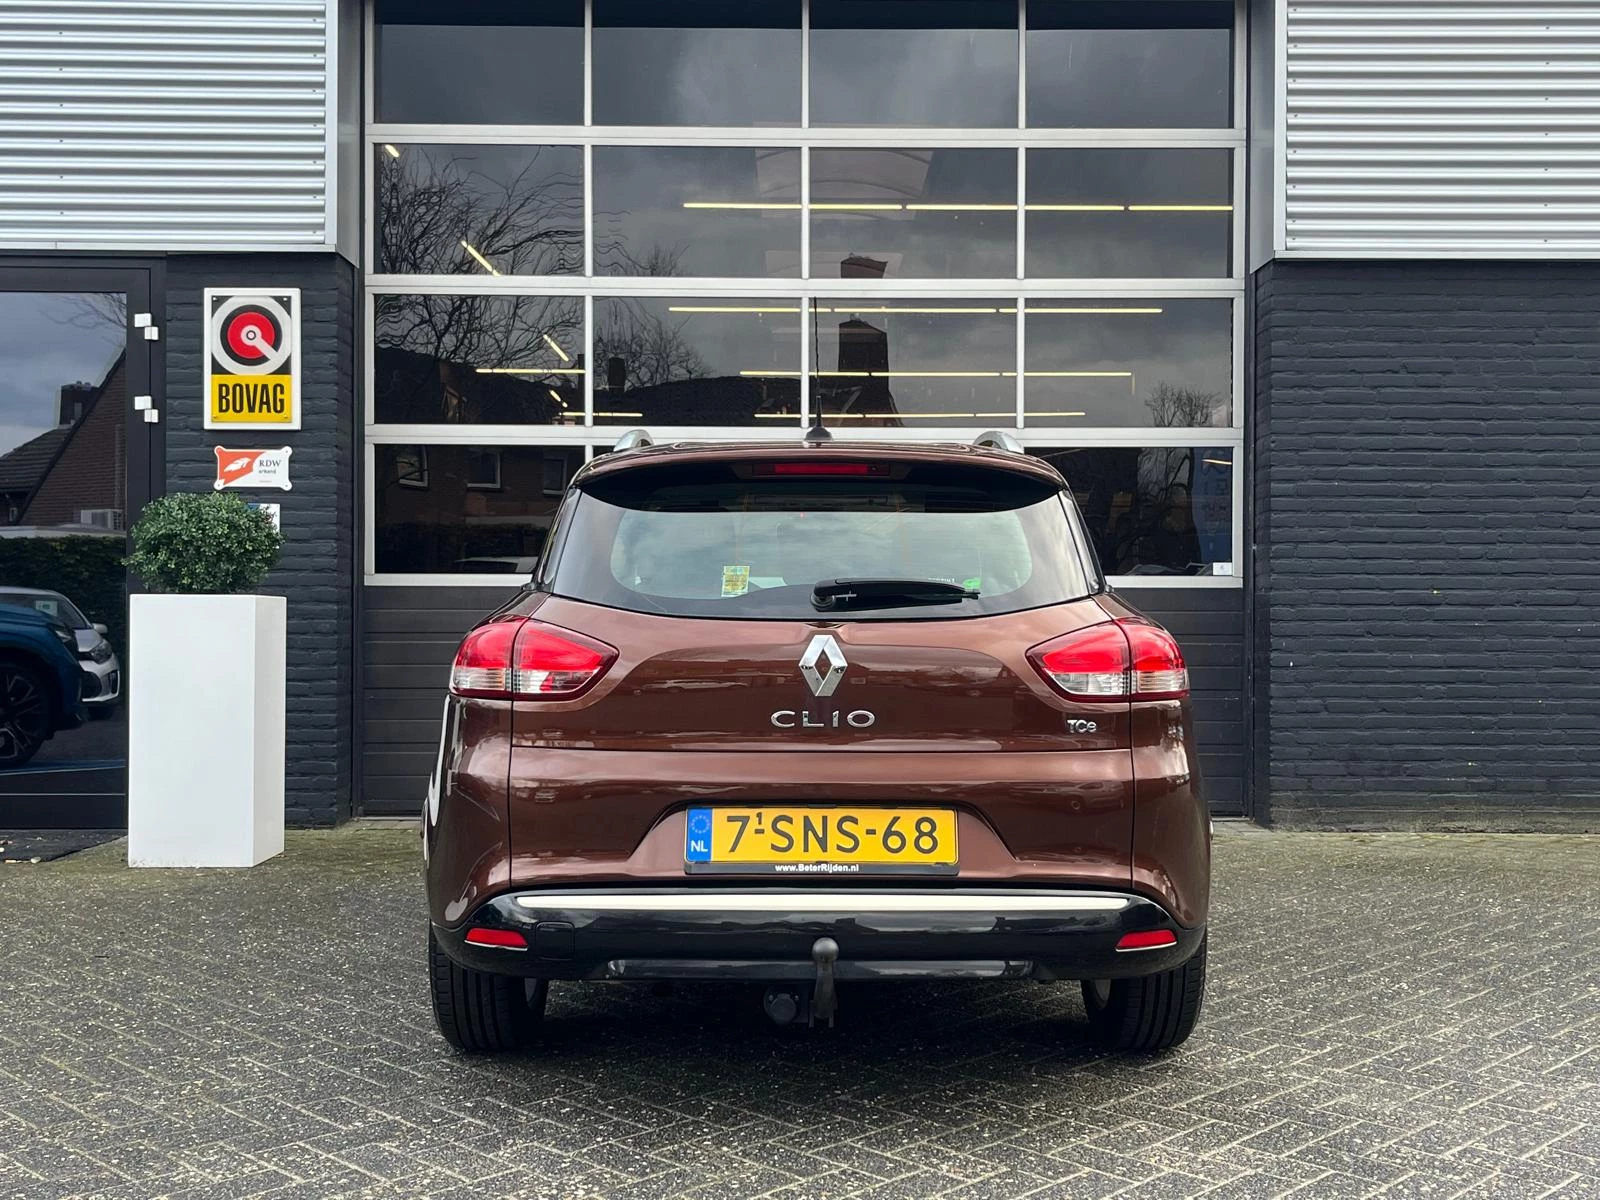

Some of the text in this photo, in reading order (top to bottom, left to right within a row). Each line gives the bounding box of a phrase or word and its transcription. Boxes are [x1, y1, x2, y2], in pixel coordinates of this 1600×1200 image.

[217, 383, 285, 414] BOVAG
[259, 459, 281, 467] RDW
[770, 710, 875, 728] CLIO
[1066, 719, 1097, 733] TCe
[690, 840, 708, 852] NL
[774, 863, 860, 873] www.BeterRijden.nl
